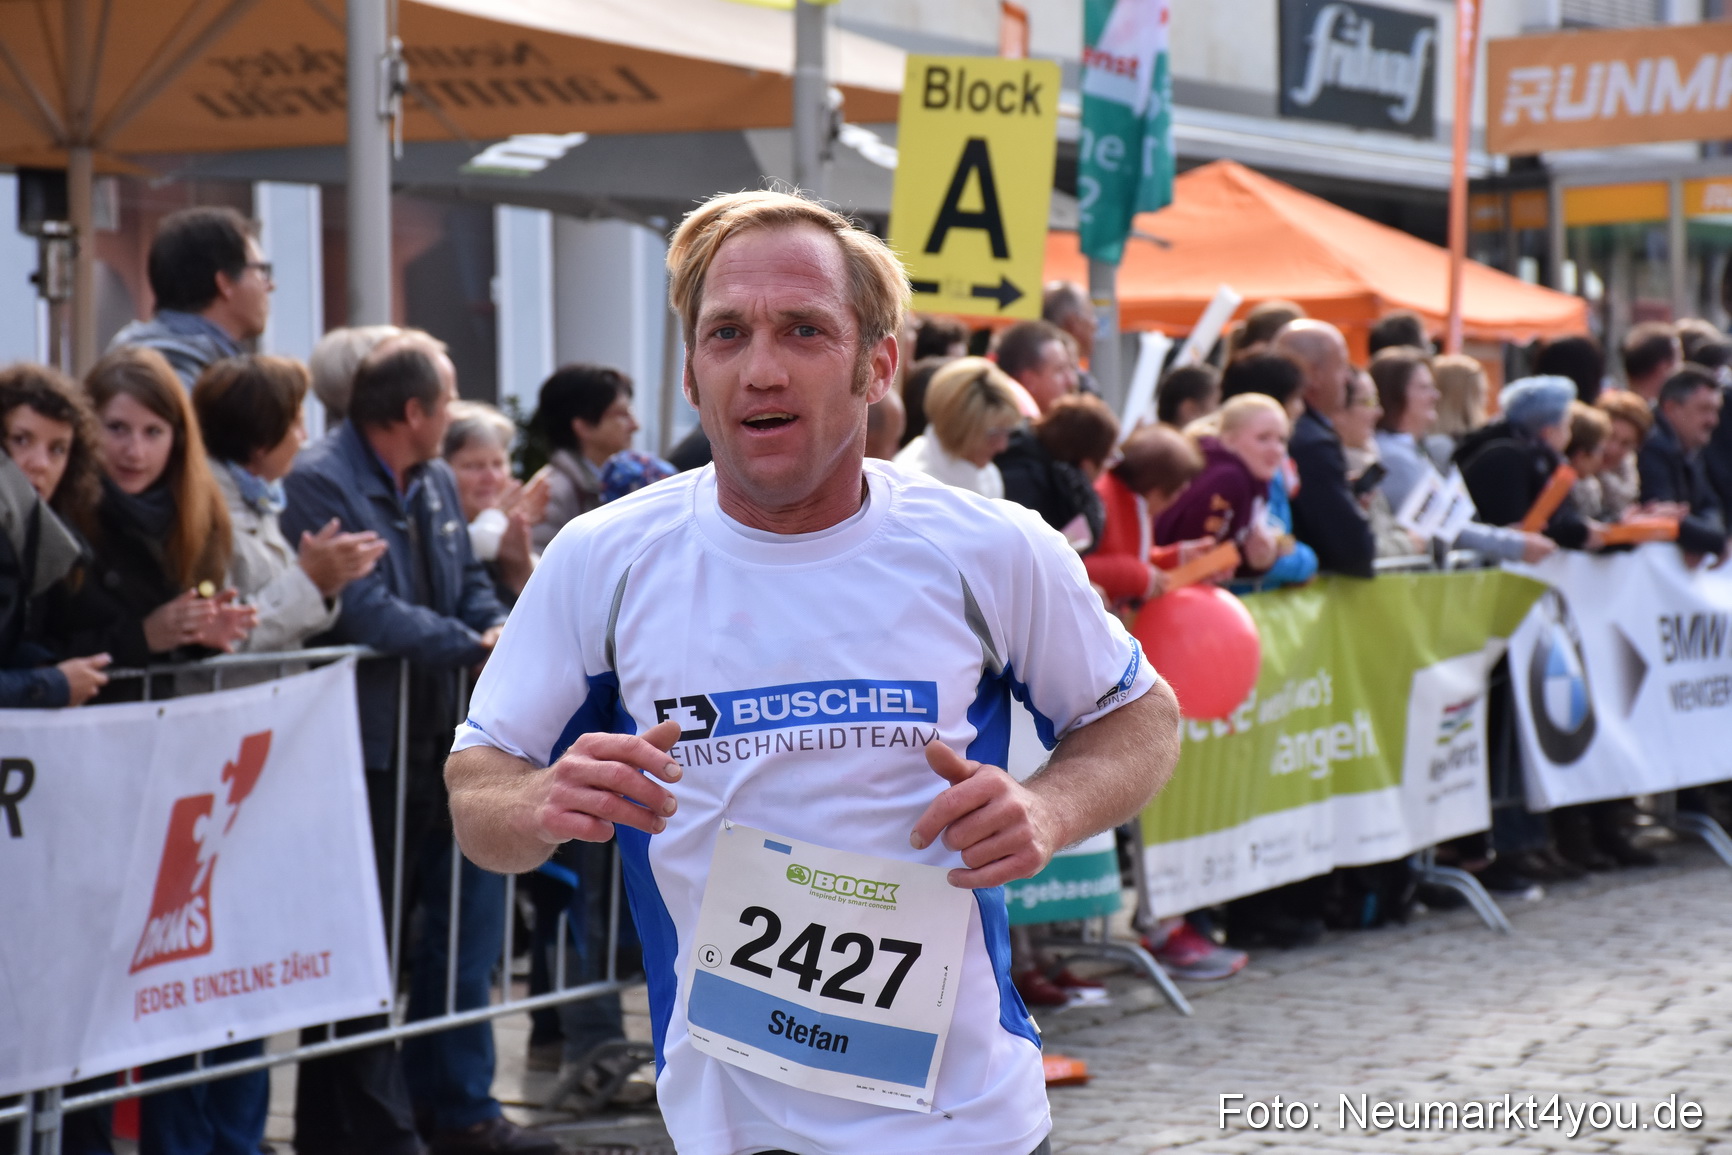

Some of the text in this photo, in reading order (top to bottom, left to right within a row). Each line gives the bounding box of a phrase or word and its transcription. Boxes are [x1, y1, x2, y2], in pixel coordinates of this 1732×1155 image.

[924, 66, 1043, 117] Block
[925, 137, 1010, 259] A
[1659, 613, 1728, 664] BMW
[732, 688, 928, 726] BÜSCHEL
[670, 726, 940, 768] EINSCHNEIDTEAM
[809, 889, 897, 911] inspired by smart concepts
[811, 869, 900, 904] BOCK
[705, 950, 715, 963] C
[730, 905, 923, 1010] 2427
[134, 950, 332, 1022] JEDER EINZELNE ZÄHLT
[768, 1009, 849, 1054] Stefan
